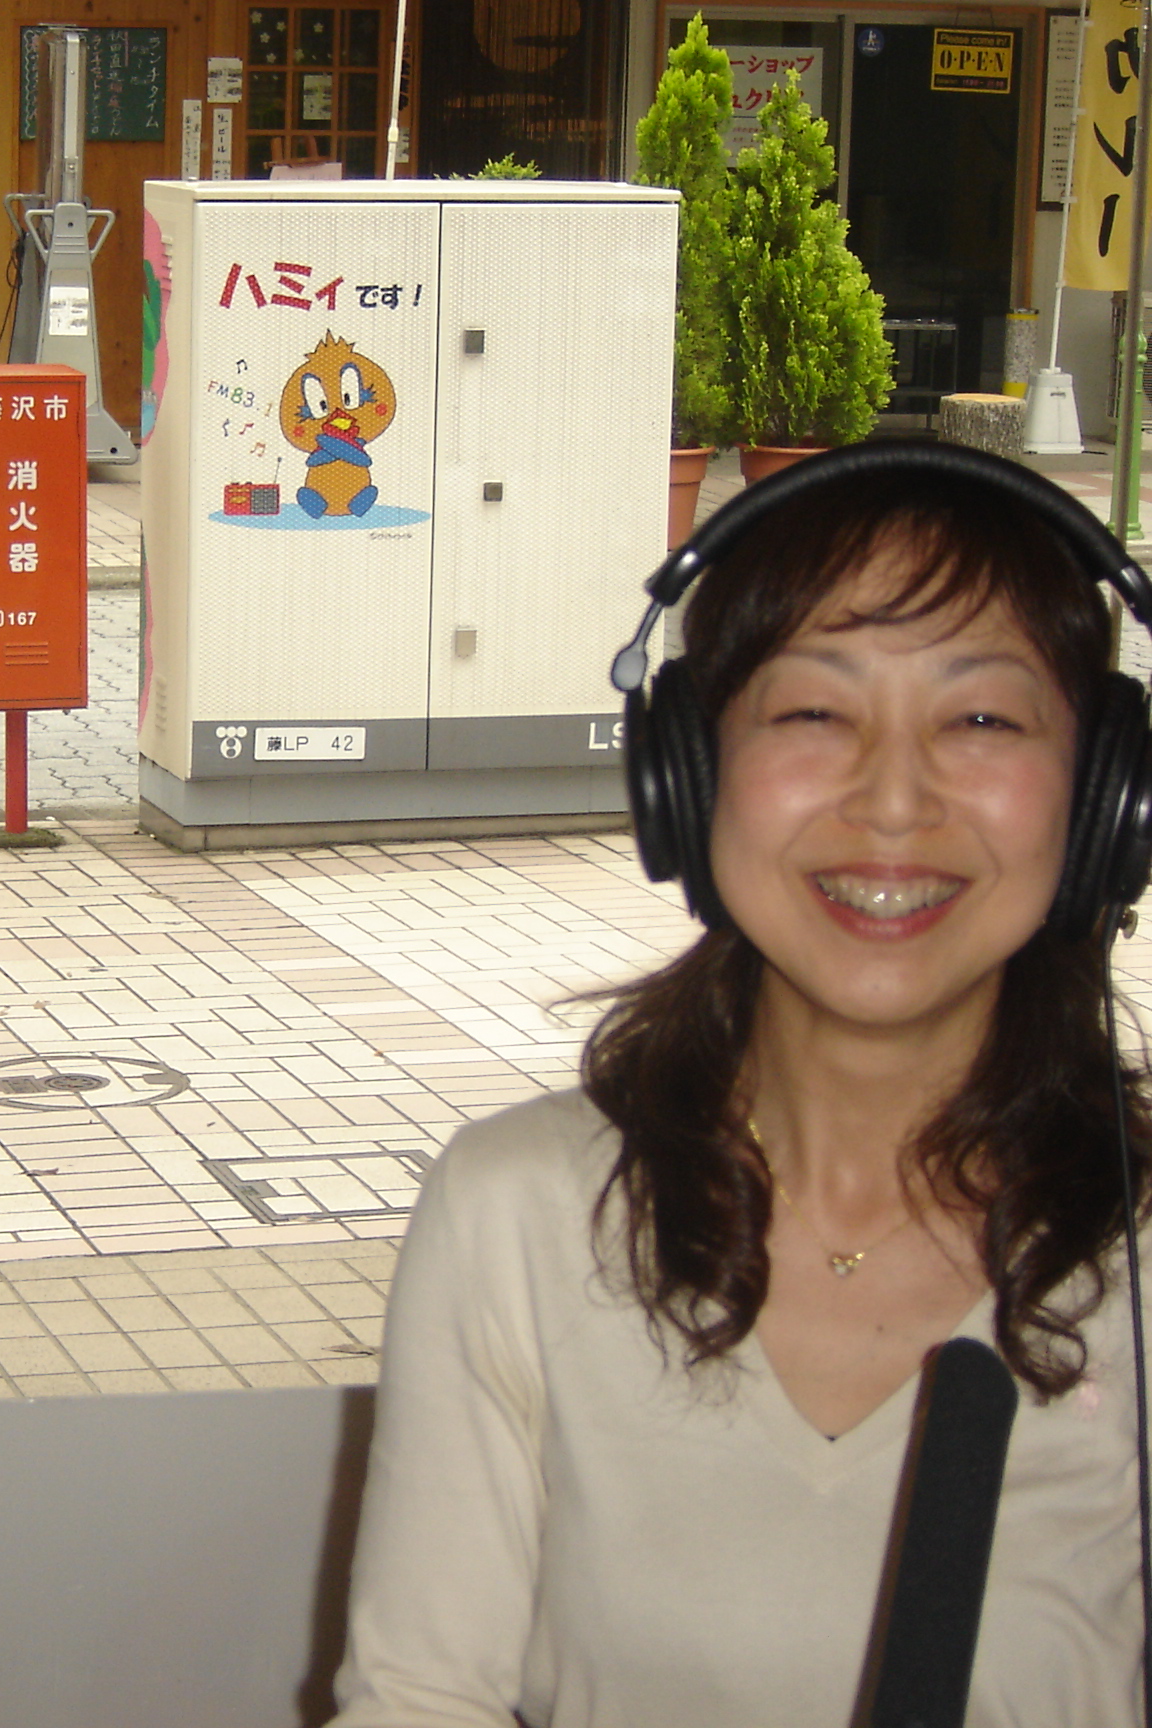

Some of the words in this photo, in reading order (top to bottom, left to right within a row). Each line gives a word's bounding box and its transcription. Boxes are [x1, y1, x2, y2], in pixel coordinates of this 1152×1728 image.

[145, 31, 162, 129] ランチタイム
[7, 460, 40, 573] 消火器
[7, 611, 37, 626] 167
[330, 735, 354, 752] 42
